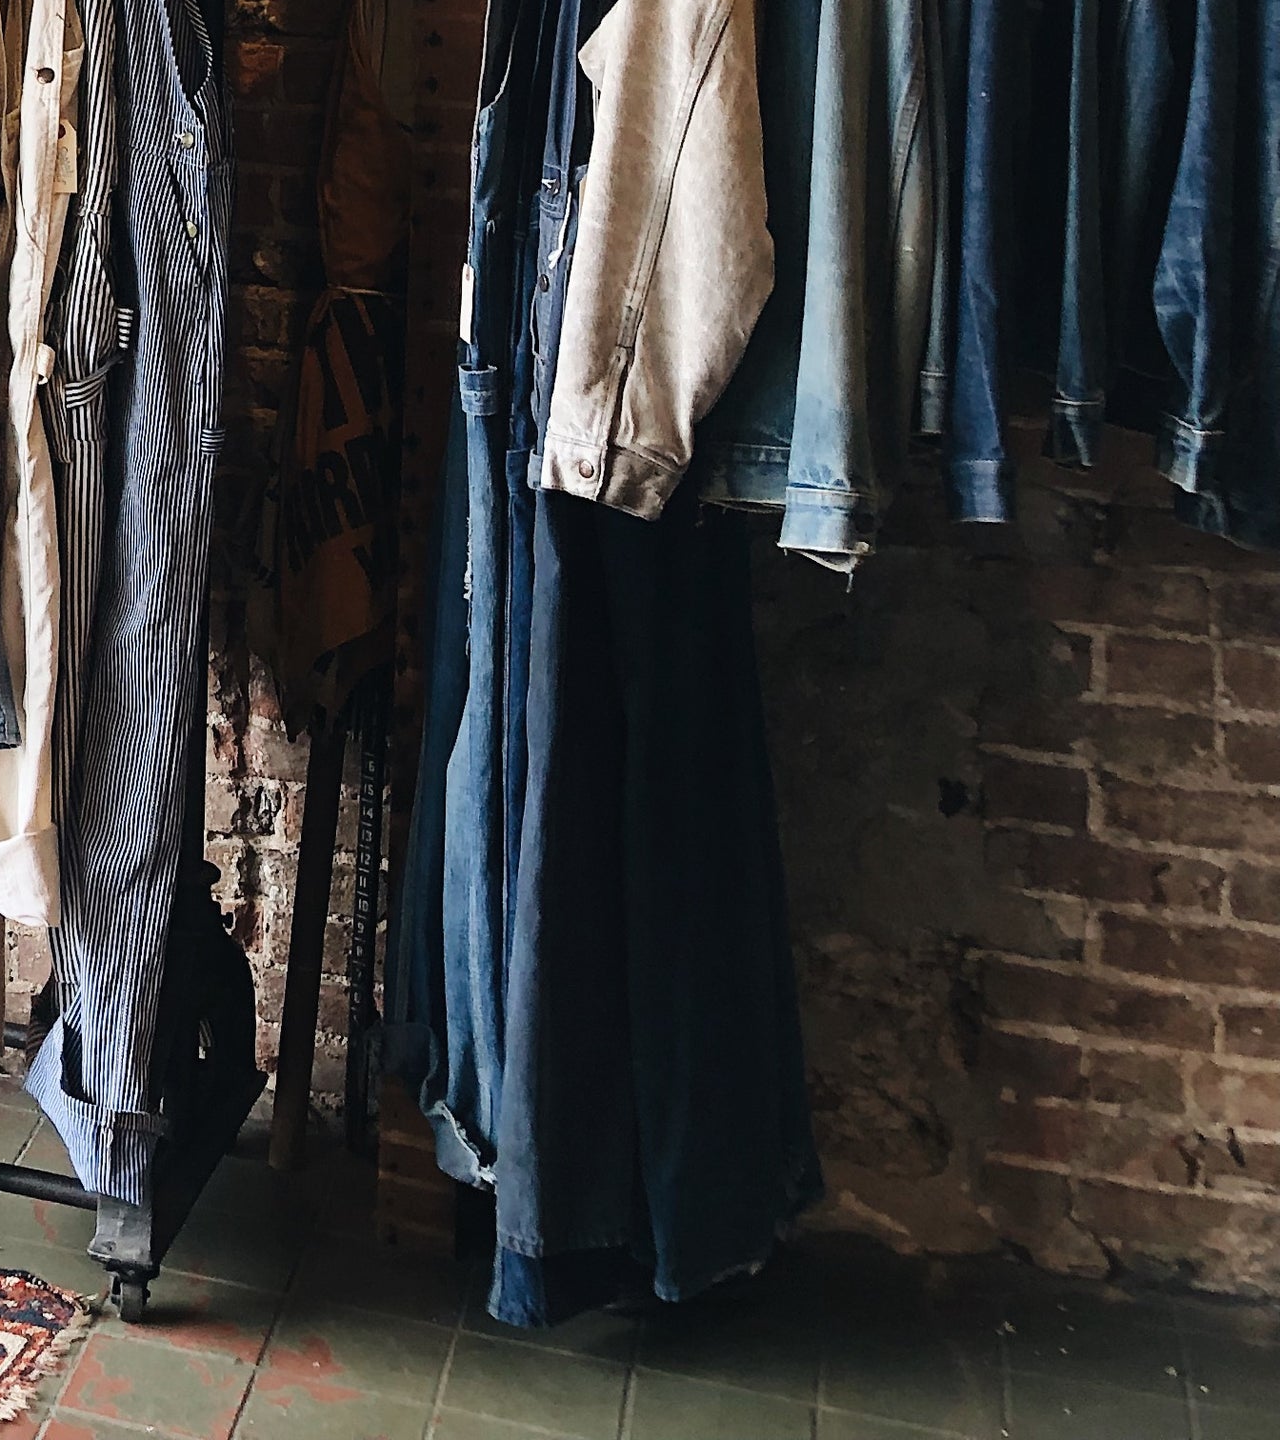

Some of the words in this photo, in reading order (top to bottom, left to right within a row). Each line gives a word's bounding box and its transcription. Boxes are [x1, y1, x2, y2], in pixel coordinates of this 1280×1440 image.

[362, 806, 374, 819] 14
[361, 829, 373, 842] 13
[360, 852, 371, 866] 12
[358, 898, 369, 912] 10
